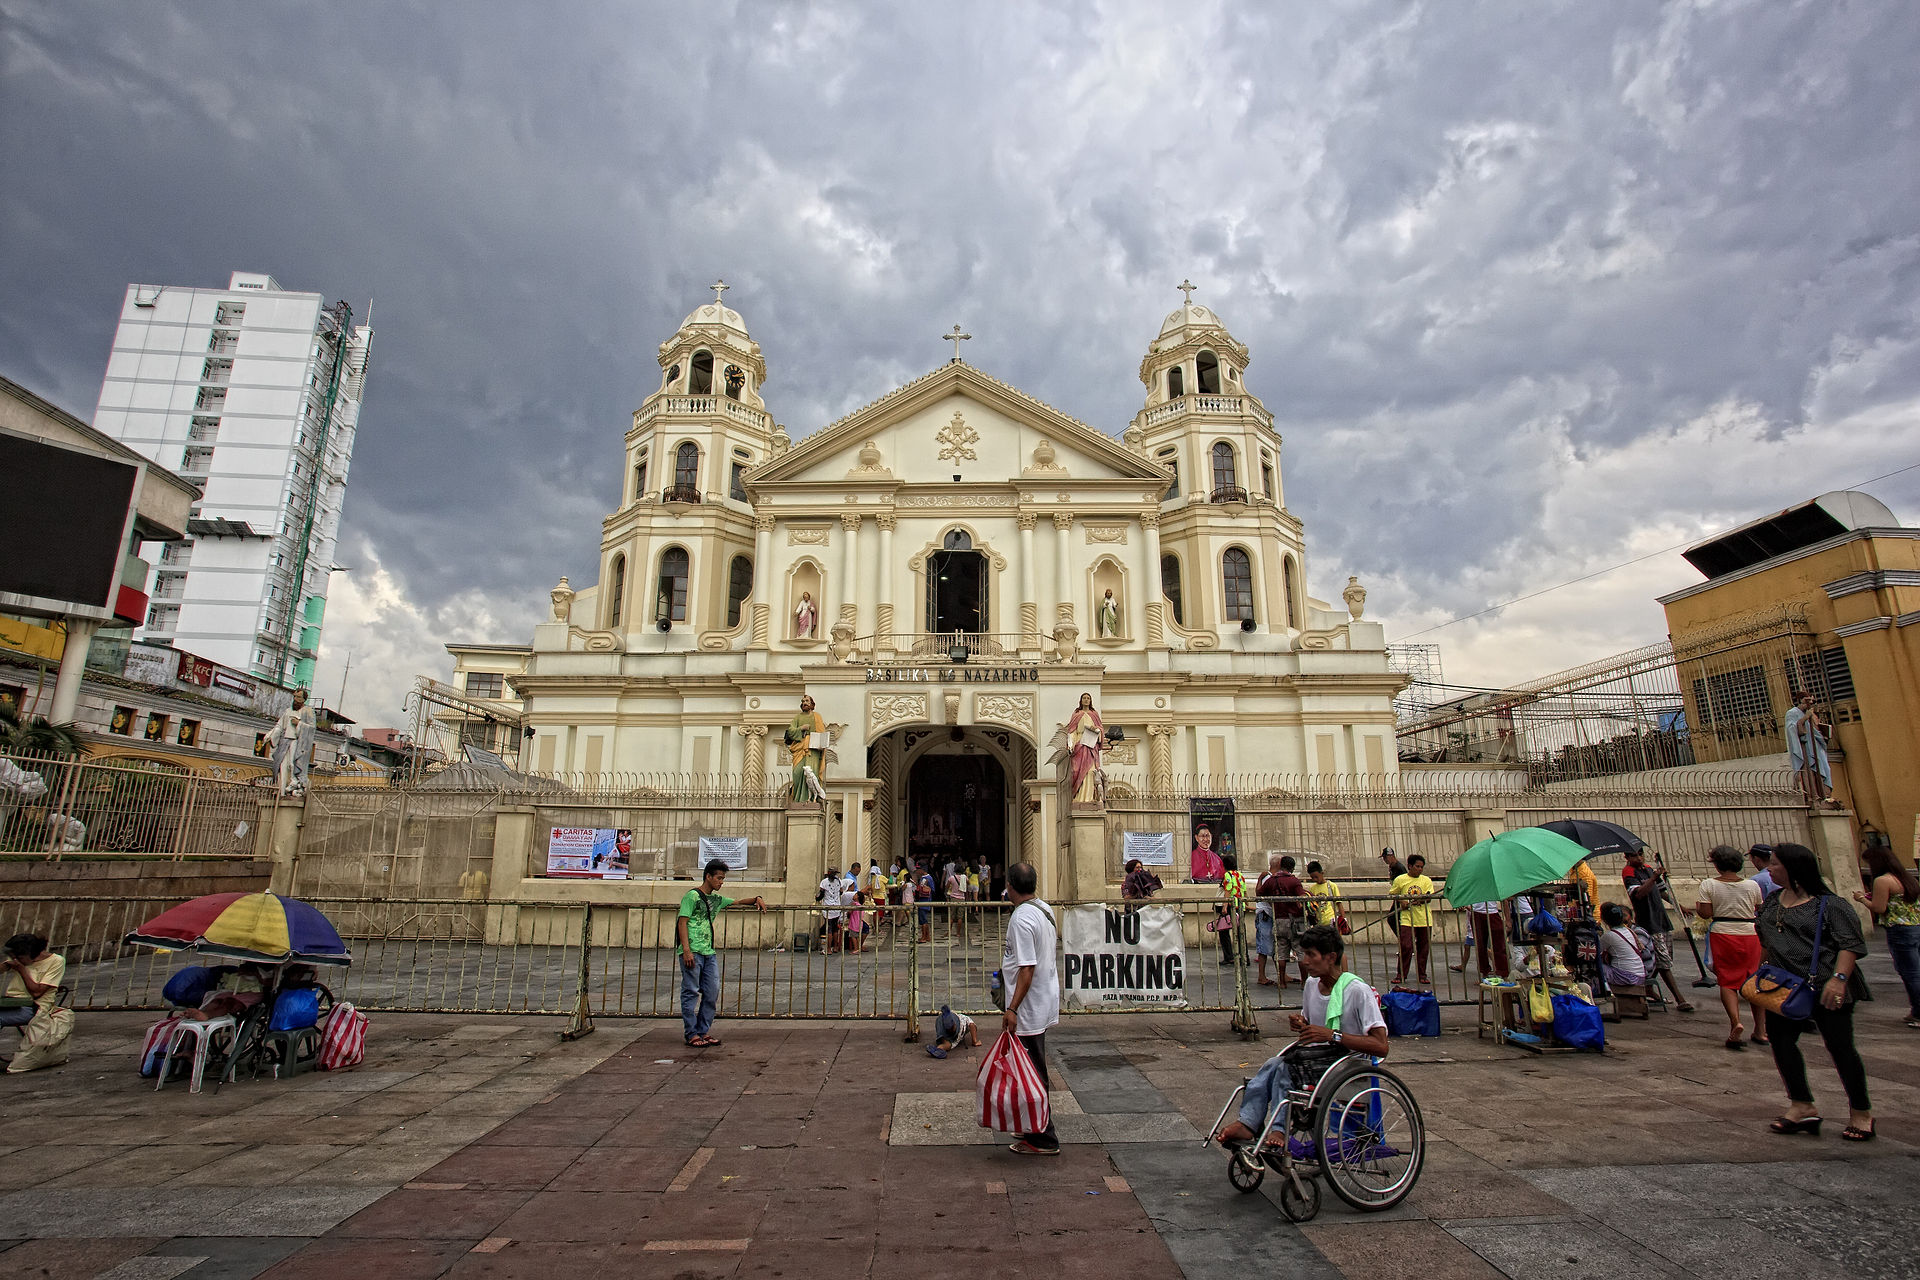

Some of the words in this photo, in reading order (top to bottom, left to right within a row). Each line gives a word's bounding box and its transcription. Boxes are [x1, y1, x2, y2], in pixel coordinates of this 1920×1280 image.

[194, 663, 212, 677] KFC
[866, 668, 929, 682] BASILIKA
[939, 668, 955, 682] NG
[964, 668, 1038, 682] NAZARENO
[563, 828, 593, 836] CARITAS
[1105, 909, 1141, 946] NO
[1064, 953, 1183, 990] PARKING
